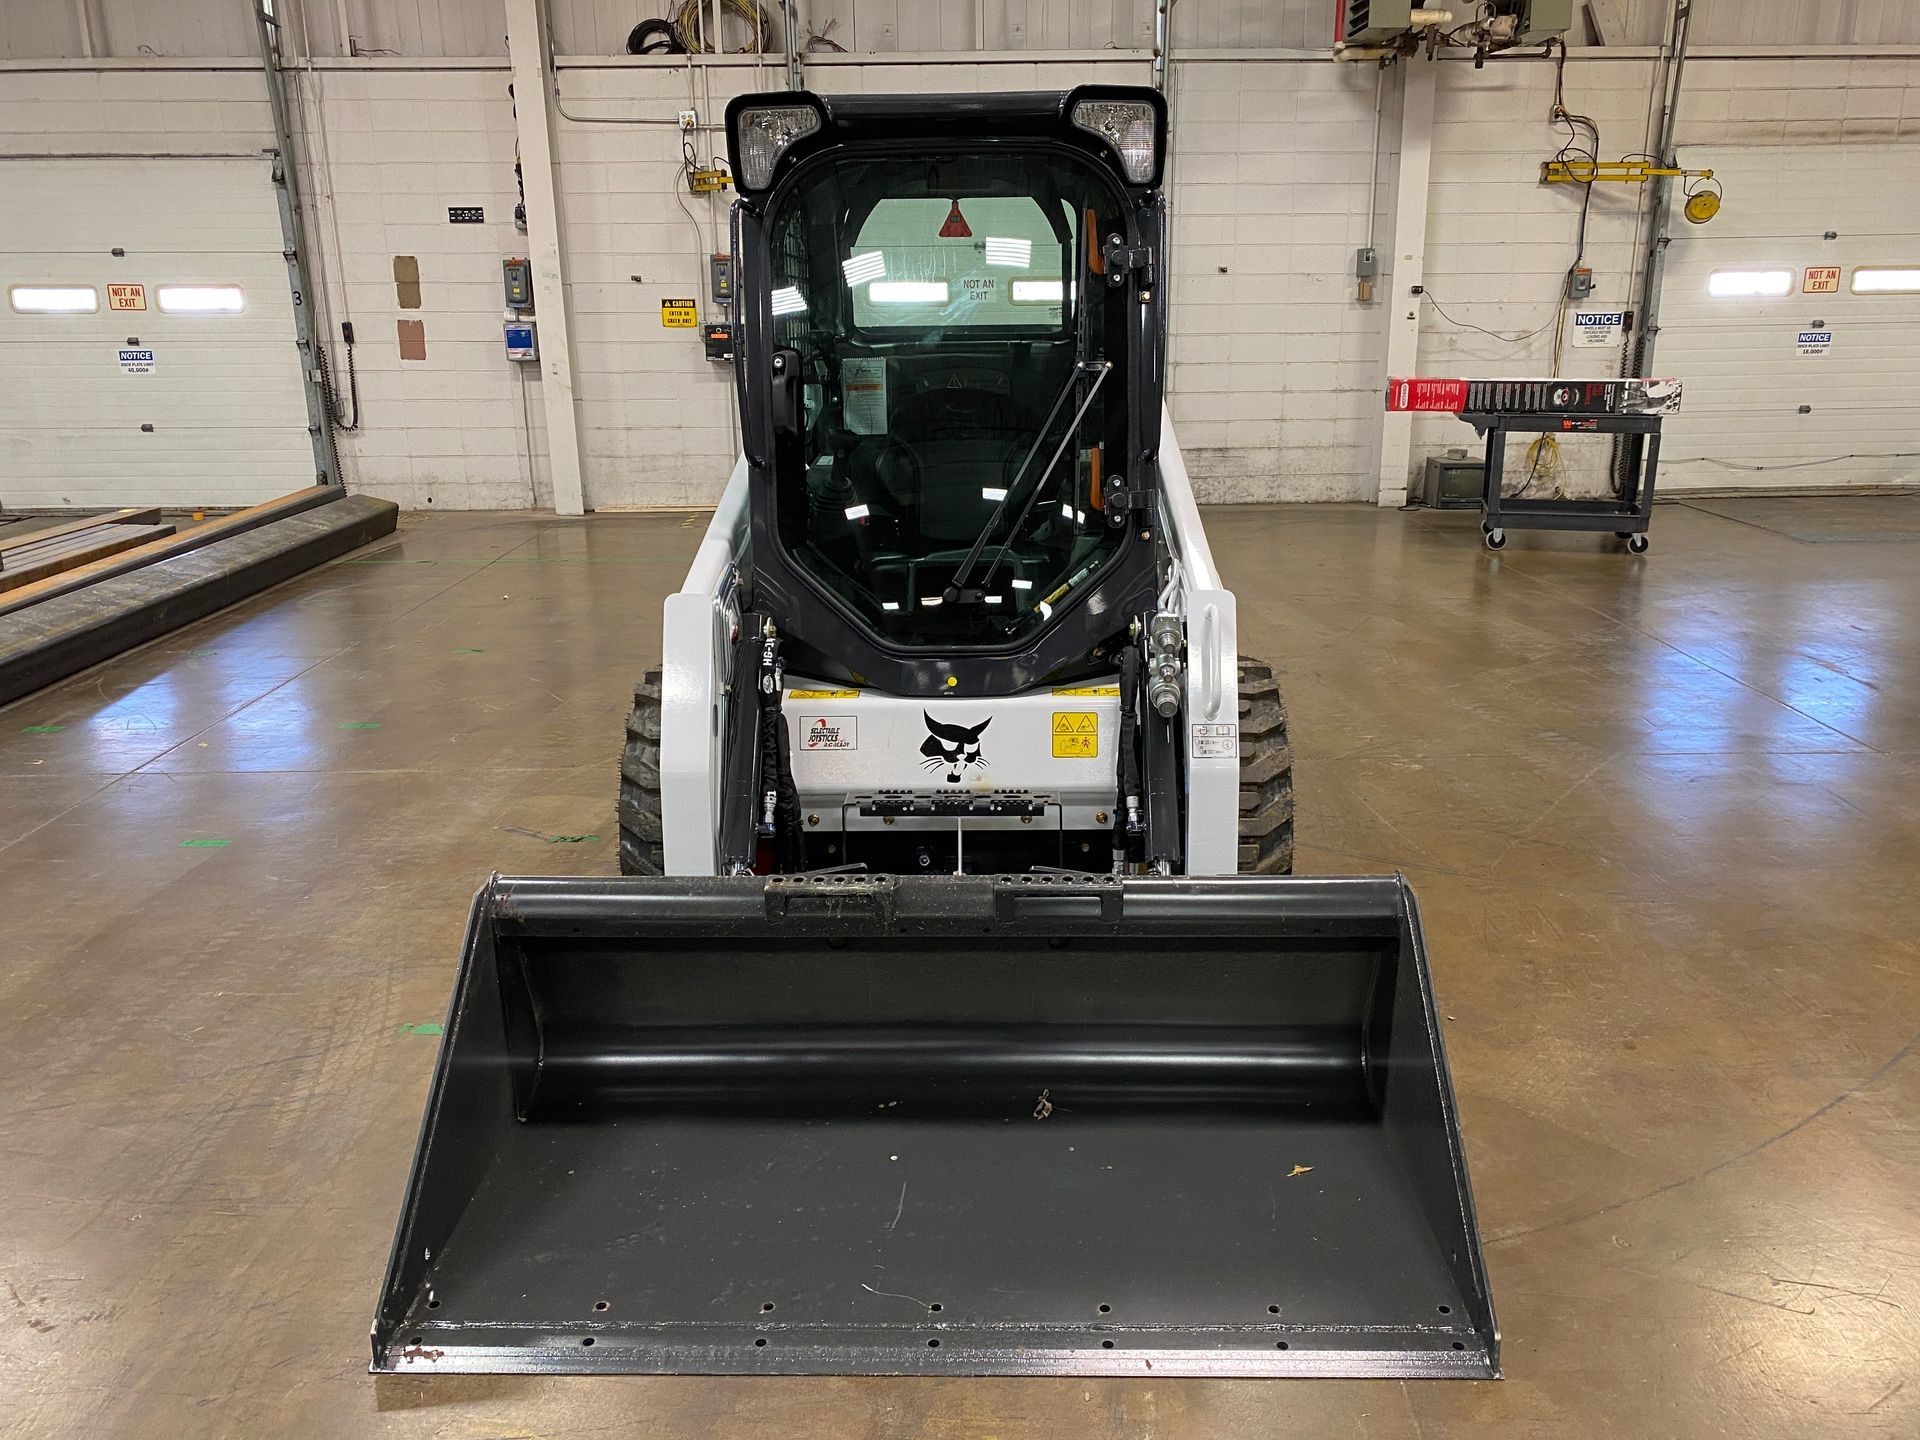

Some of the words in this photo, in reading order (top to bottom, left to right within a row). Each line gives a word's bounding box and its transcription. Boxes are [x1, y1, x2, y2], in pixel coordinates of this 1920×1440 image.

[1809, 270, 1823, 280] NOT
[1826, 270, 1836, 280] AN
[964, 280, 980, 288] NOT
[982, 280, 994, 288] AN
[1812, 281, 1830, 290] EXIT
[112, 288, 126, 296] NOT
[130, 288, 140, 296] AN
[970, 292, 988, 300] EXIT
[293, 290, 302, 306] 3
[119, 298, 136, 308] EXIT
[1577, 314, 1620, 325] NOTICE
[1800, 334, 1830, 342] NOTICE
[120, 352, 152, 360] NOTICE
